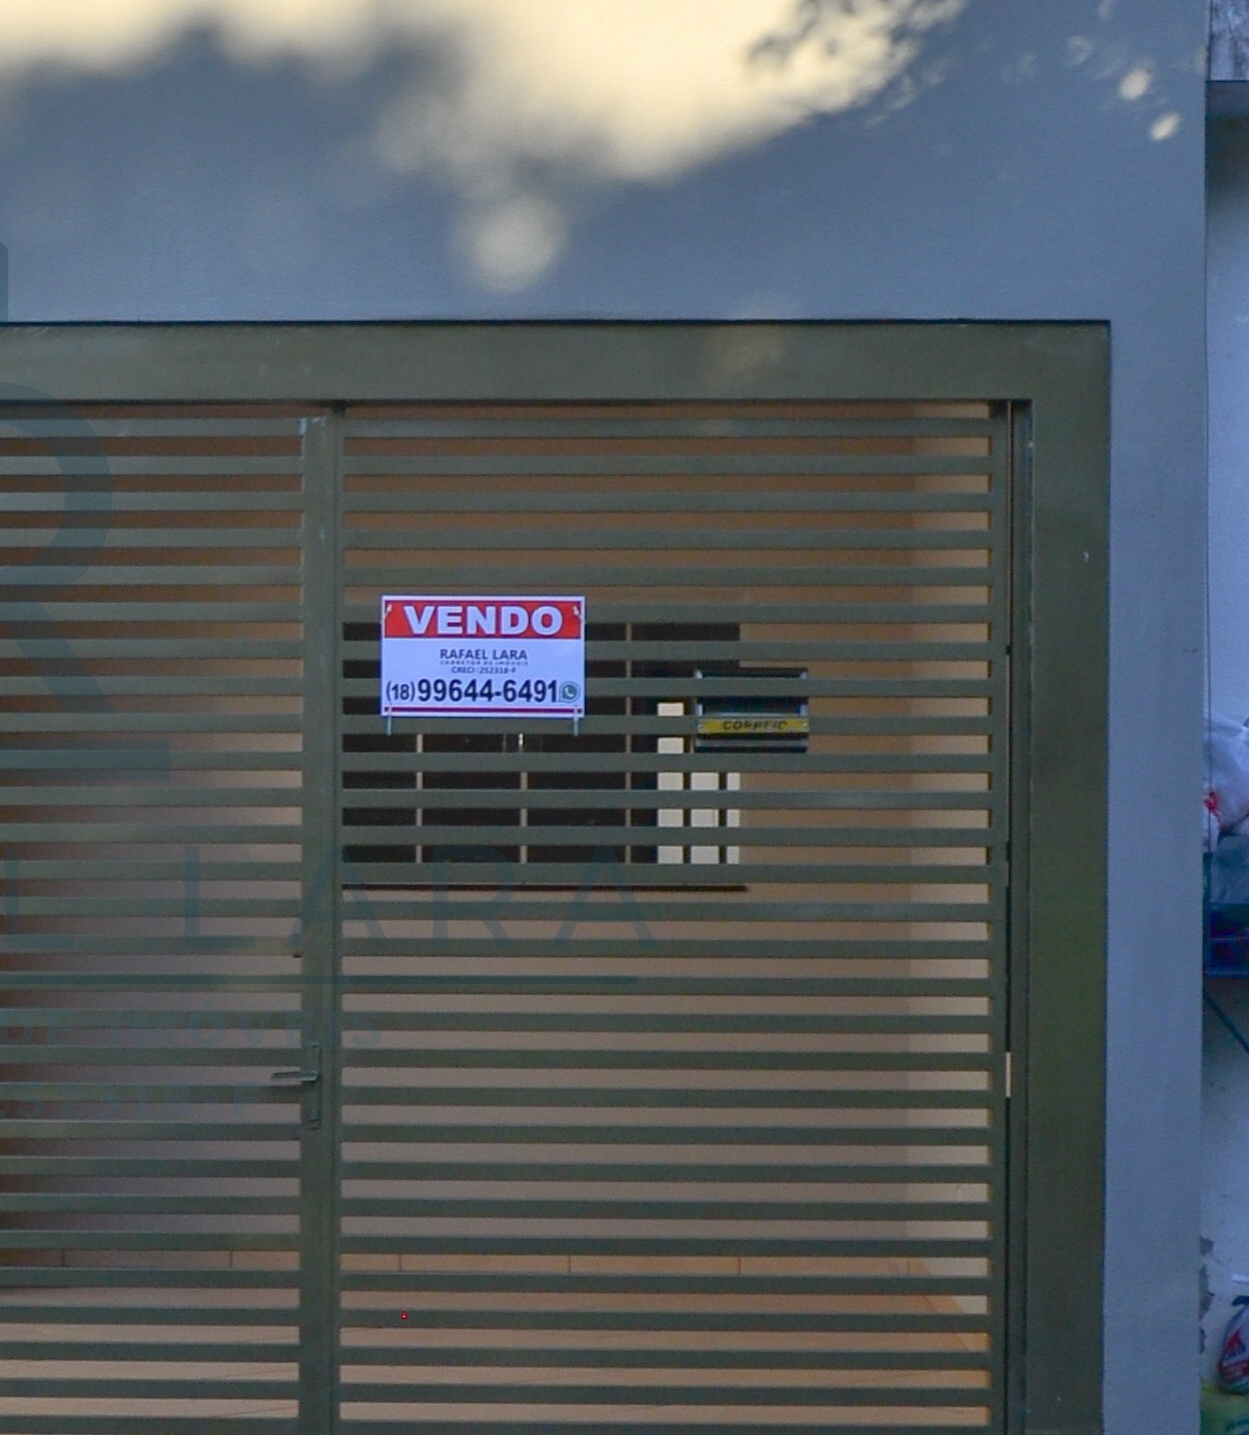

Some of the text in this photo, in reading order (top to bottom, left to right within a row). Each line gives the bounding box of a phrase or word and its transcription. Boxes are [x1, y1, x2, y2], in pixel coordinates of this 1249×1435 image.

[404, 605, 563, 636] VENDO
[440, 649, 528, 661] RAFAEL LARA
[386, 678, 557, 703] (18) 99644-6491
